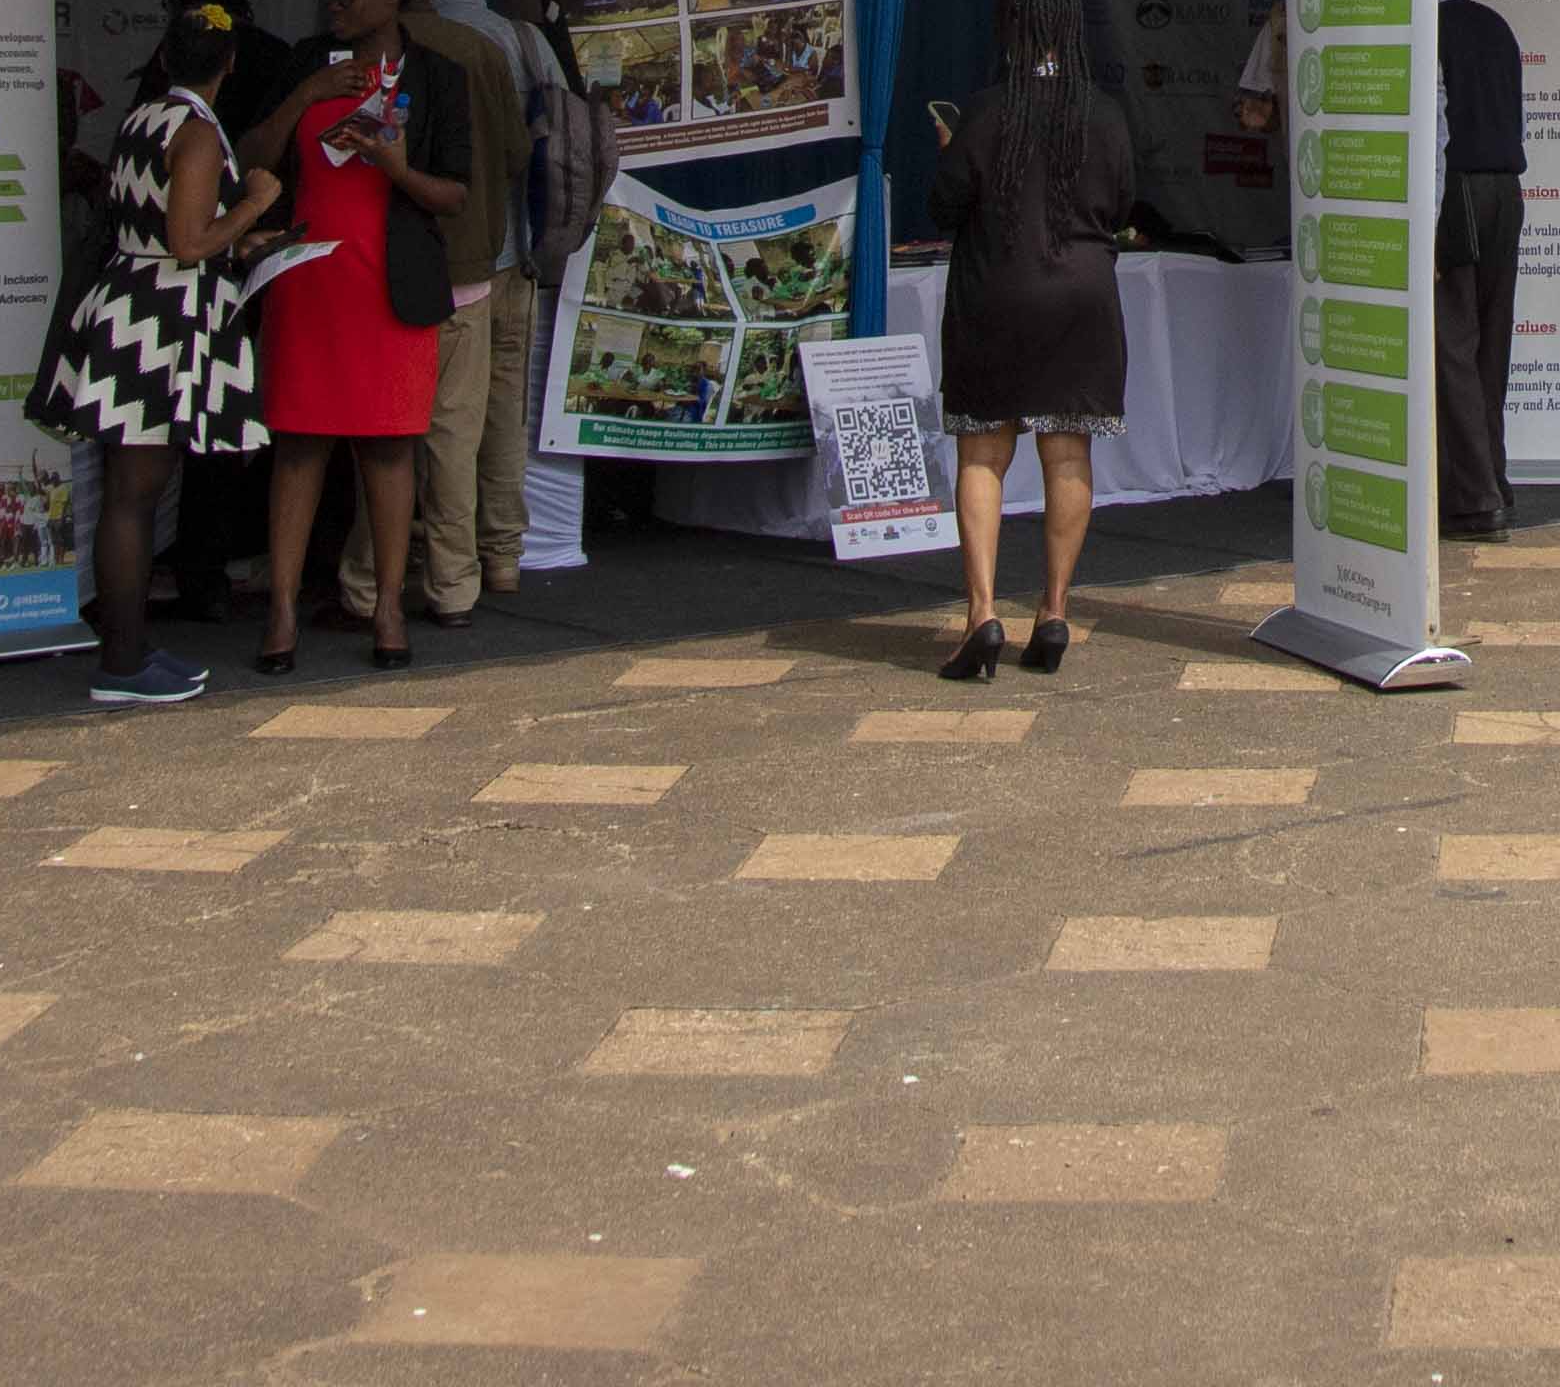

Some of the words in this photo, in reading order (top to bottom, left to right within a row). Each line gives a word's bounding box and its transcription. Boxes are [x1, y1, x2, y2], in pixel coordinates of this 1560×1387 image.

[1534, 128, 1544, 140] of
[715, 214, 784, 236] TREASURE
[3, 273, 48, 286] Inclusion
